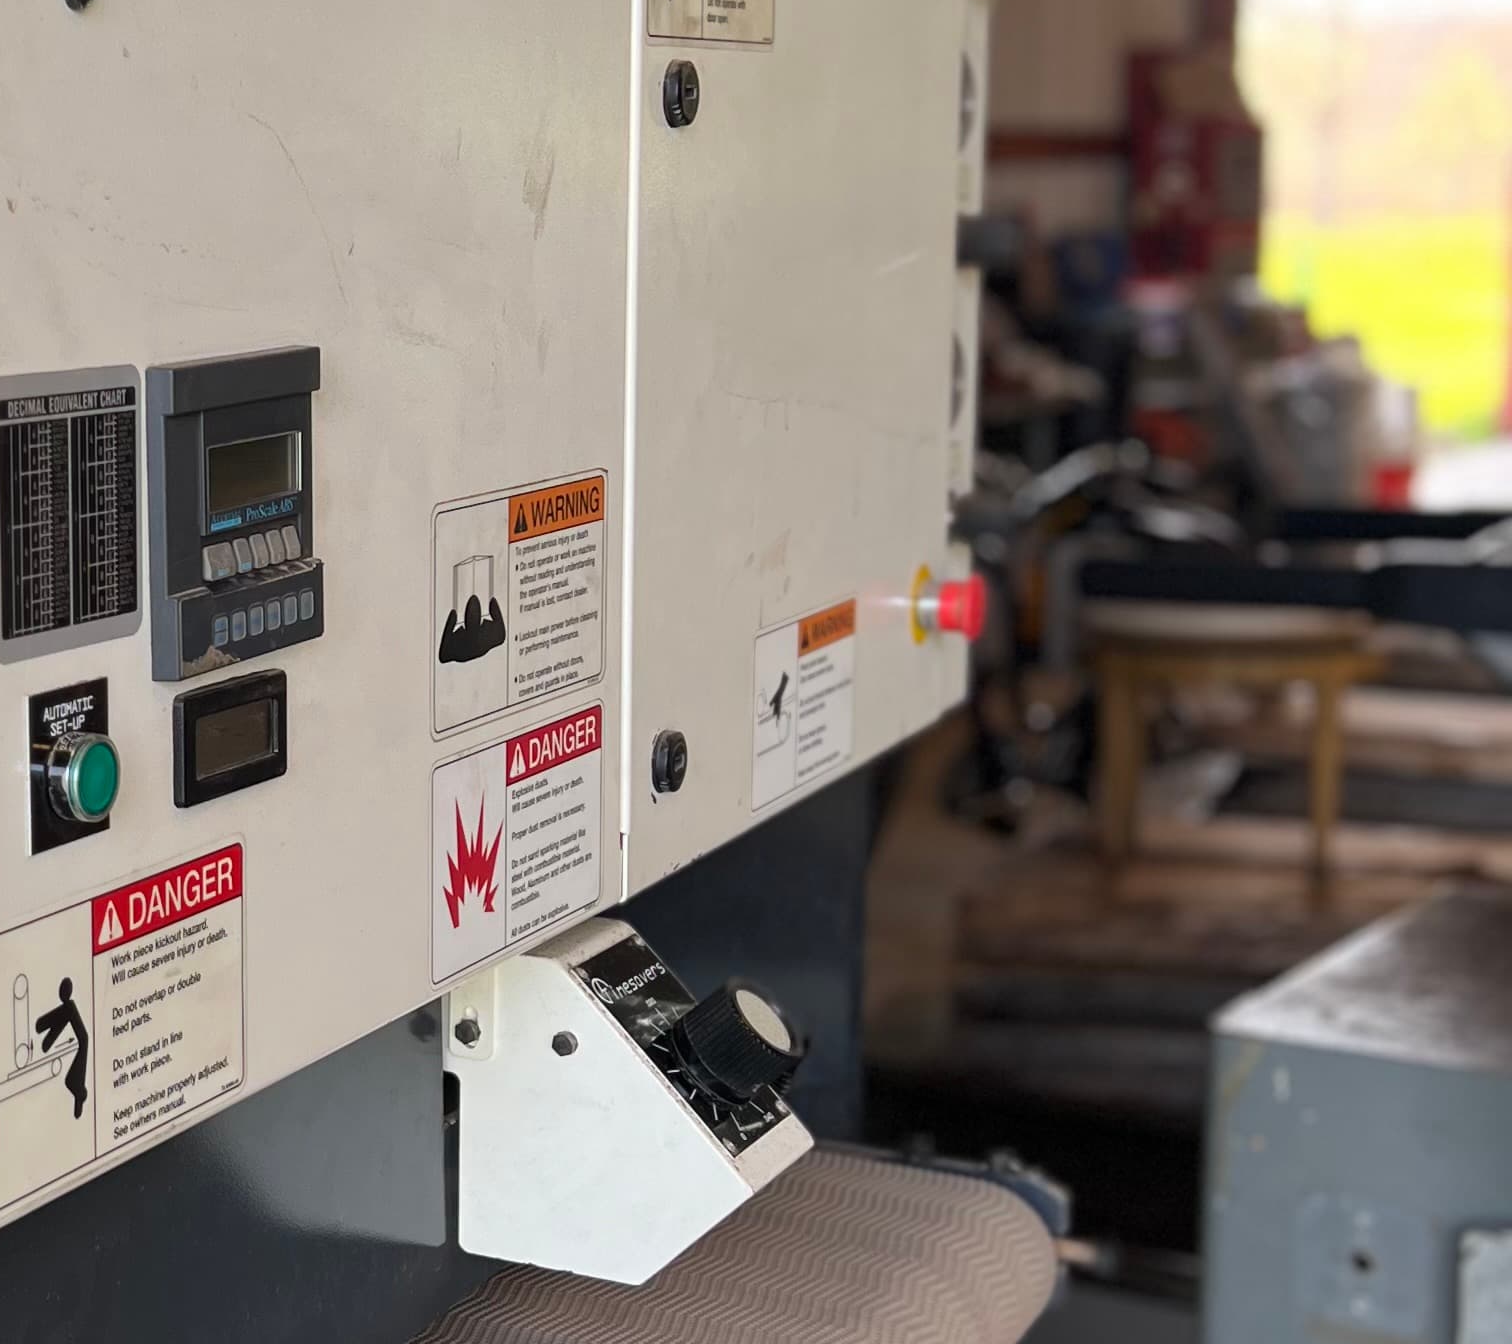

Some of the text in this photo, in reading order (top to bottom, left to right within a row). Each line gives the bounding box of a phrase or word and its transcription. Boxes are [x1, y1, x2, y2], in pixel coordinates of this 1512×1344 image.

[8, 389, 126, 418] DECIMAL EQUIVALENT CHART
[531, 486, 600, 527] WARNING
[43, 695, 95, 723] AUTOMATIC
[50, 714, 85, 737] SET-UP
[529, 715, 596, 769] DANGER
[128, 857, 234, 932] DANGER
[111, 951, 131, 968] Work
[133, 943, 153, 961] piece
[155, 930, 182, 950] kickout
[111, 969, 126, 986] Will
[127, 962, 149, 978] cause
[151, 951, 175, 968] severe
[177, 941, 196, 958] injury
[197, 939, 205, 949] or
[112, 972, 201, 1020] Do not overlap or double
[113, 1032, 183, 1071] Do not stand in line
[113, 1072, 129, 1088] with
[131, 1062, 148, 1080] work
[114, 1106, 133, 1122] Keep
[135, 1089, 165, 1112] machine
[167, 1073, 196, 1097] properly
[113, 1125, 128, 1139] See
[130, 1110, 157, 1131] owners
